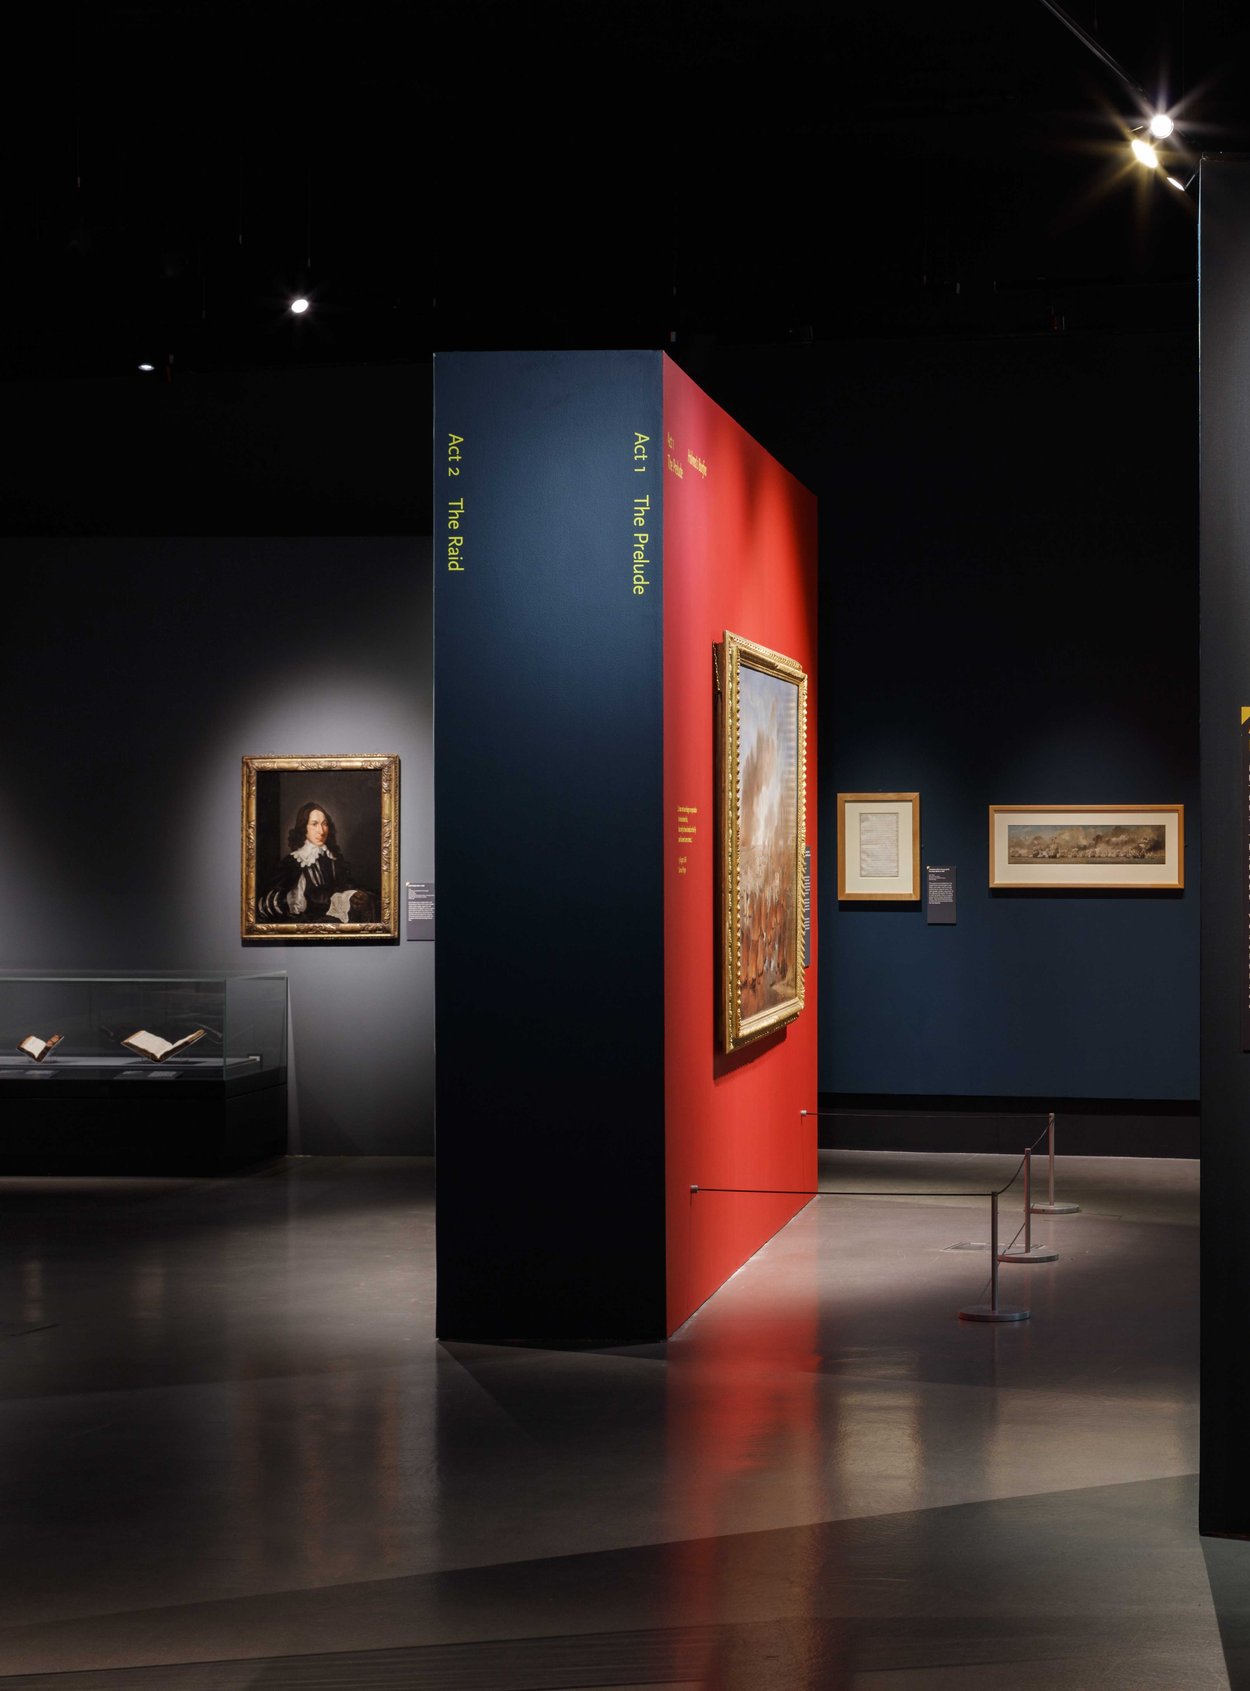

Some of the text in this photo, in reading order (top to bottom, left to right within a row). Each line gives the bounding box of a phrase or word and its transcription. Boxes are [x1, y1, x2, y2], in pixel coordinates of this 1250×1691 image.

[448, 433, 464, 476] Act 2
[634, 432, 650, 461] Act
[448, 498, 465, 571] The Raid
[633, 494, 650, 595] The Prelude
